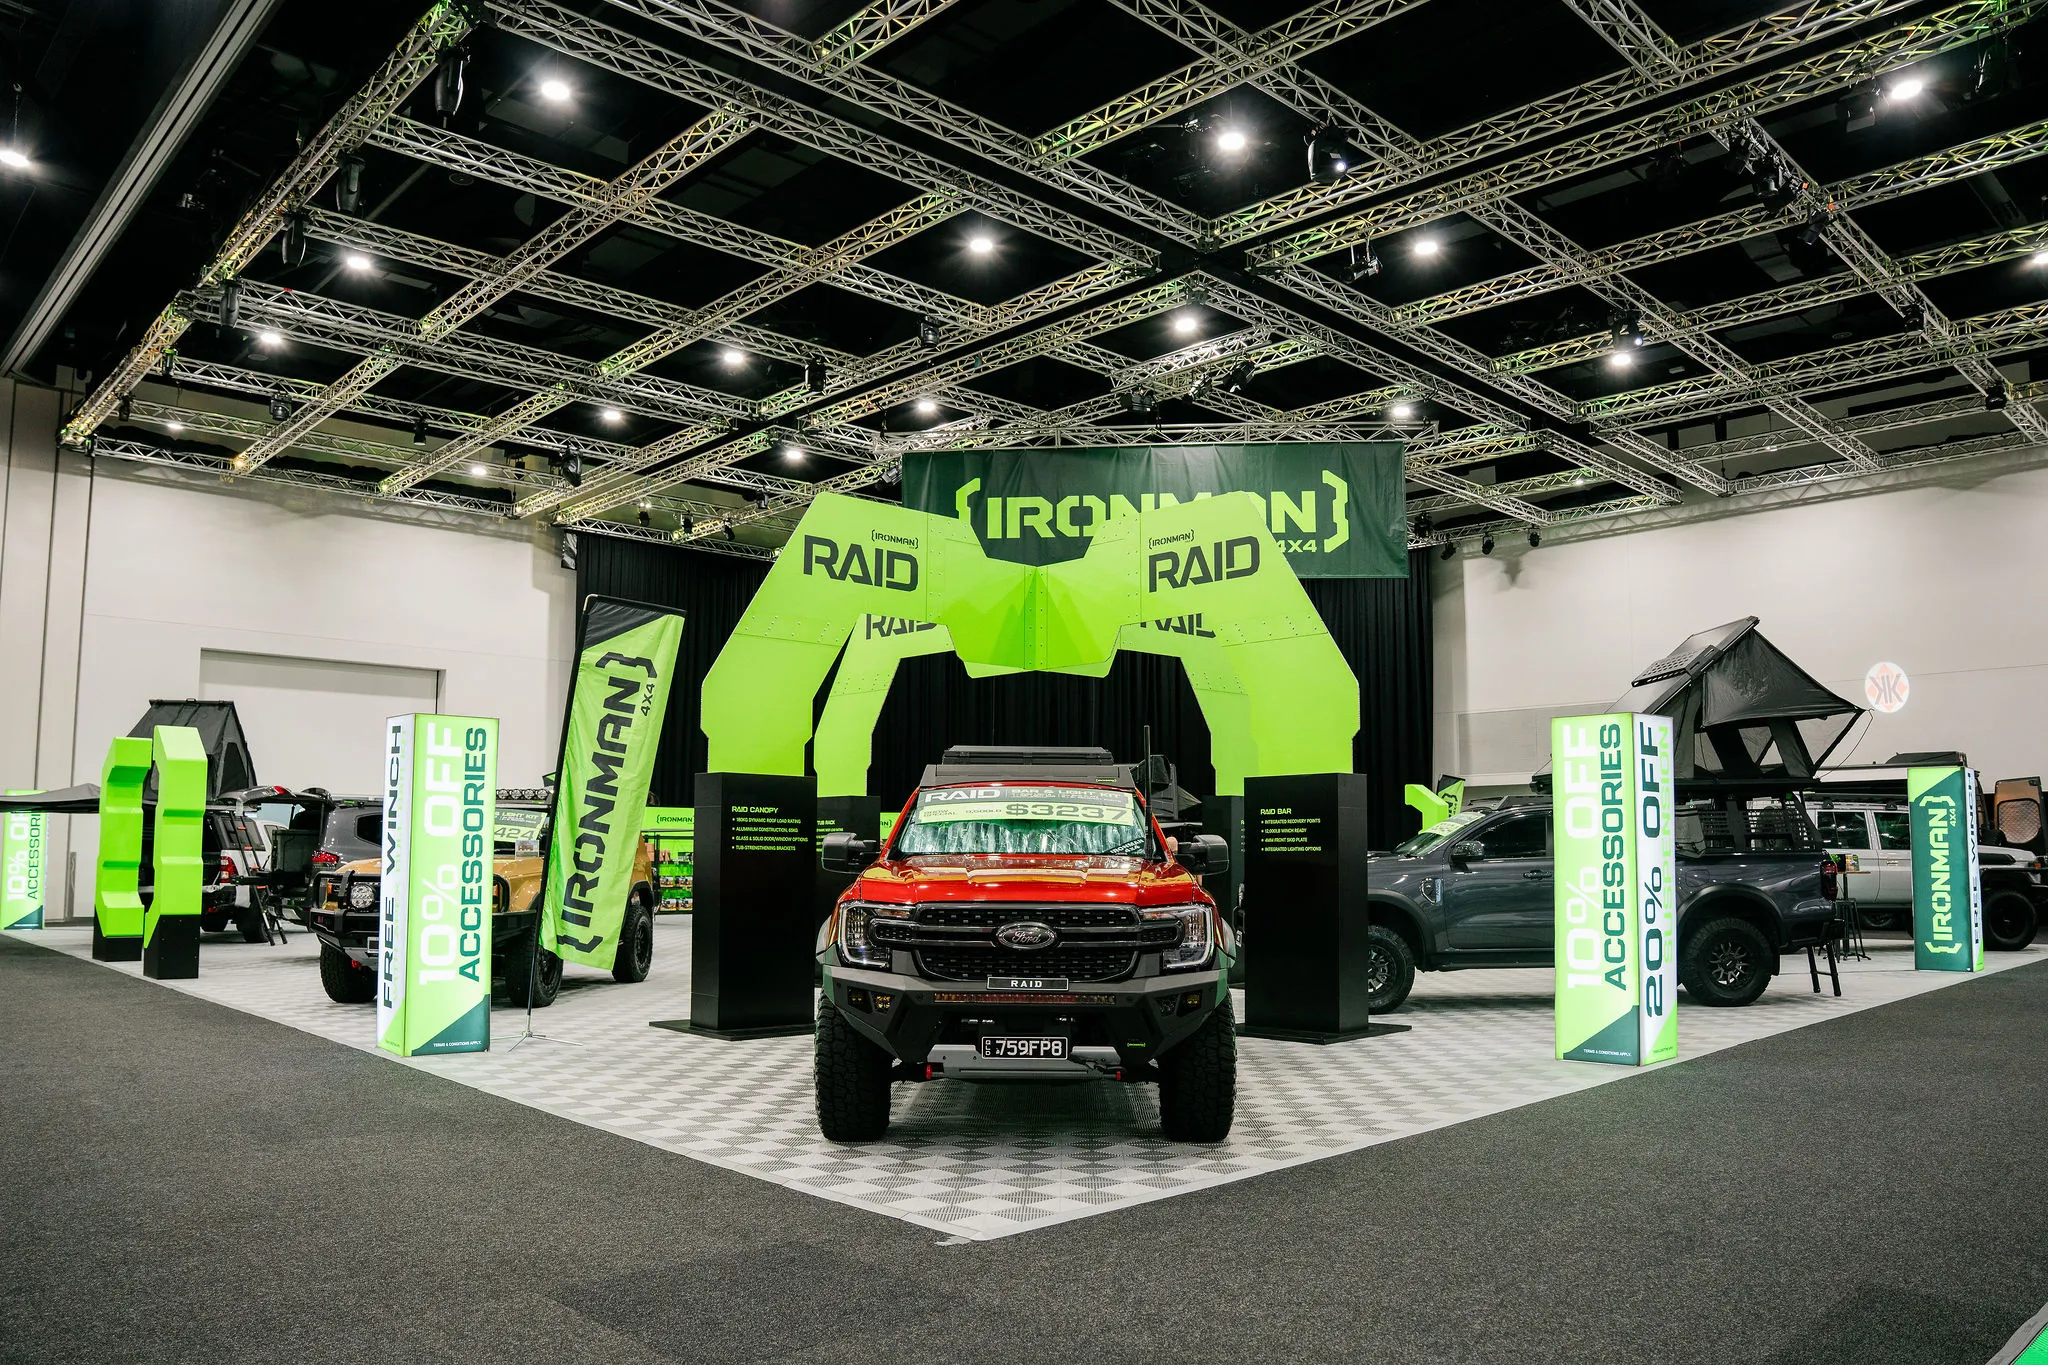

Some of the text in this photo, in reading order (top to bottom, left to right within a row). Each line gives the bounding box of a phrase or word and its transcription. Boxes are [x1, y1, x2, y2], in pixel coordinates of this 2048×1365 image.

[803, 534, 919, 592] RAID
[1149, 535, 1260, 593] RAID
[641, 683, 656, 716] 4X4
[750, 806, 778, 814] CANOPY
[925, 789, 1000, 803] RAID
[1006, 803, 1127, 820] $3237
[383, 725, 401, 1009] FREE WINCH
[418, 722, 462, 985] 10% OFF
[459, 728, 486, 983] ACCESSORIES
[1109, 838, 1144, 853] IRONMAN
[1563, 725, 1603, 988] 10% OFF
[1600, 723, 1626, 991] ACCESSORIES
[1640, 722, 1663, 1017] 20% OFF
[1658, 726, 1673, 964] SUSPENSION
[7, 850, 28, 901] 10%
[1012, 931, 1041, 943] Ford
[1010, 980, 1043, 988] RAID
[996, 1040, 1062, 1056] 759FP8
